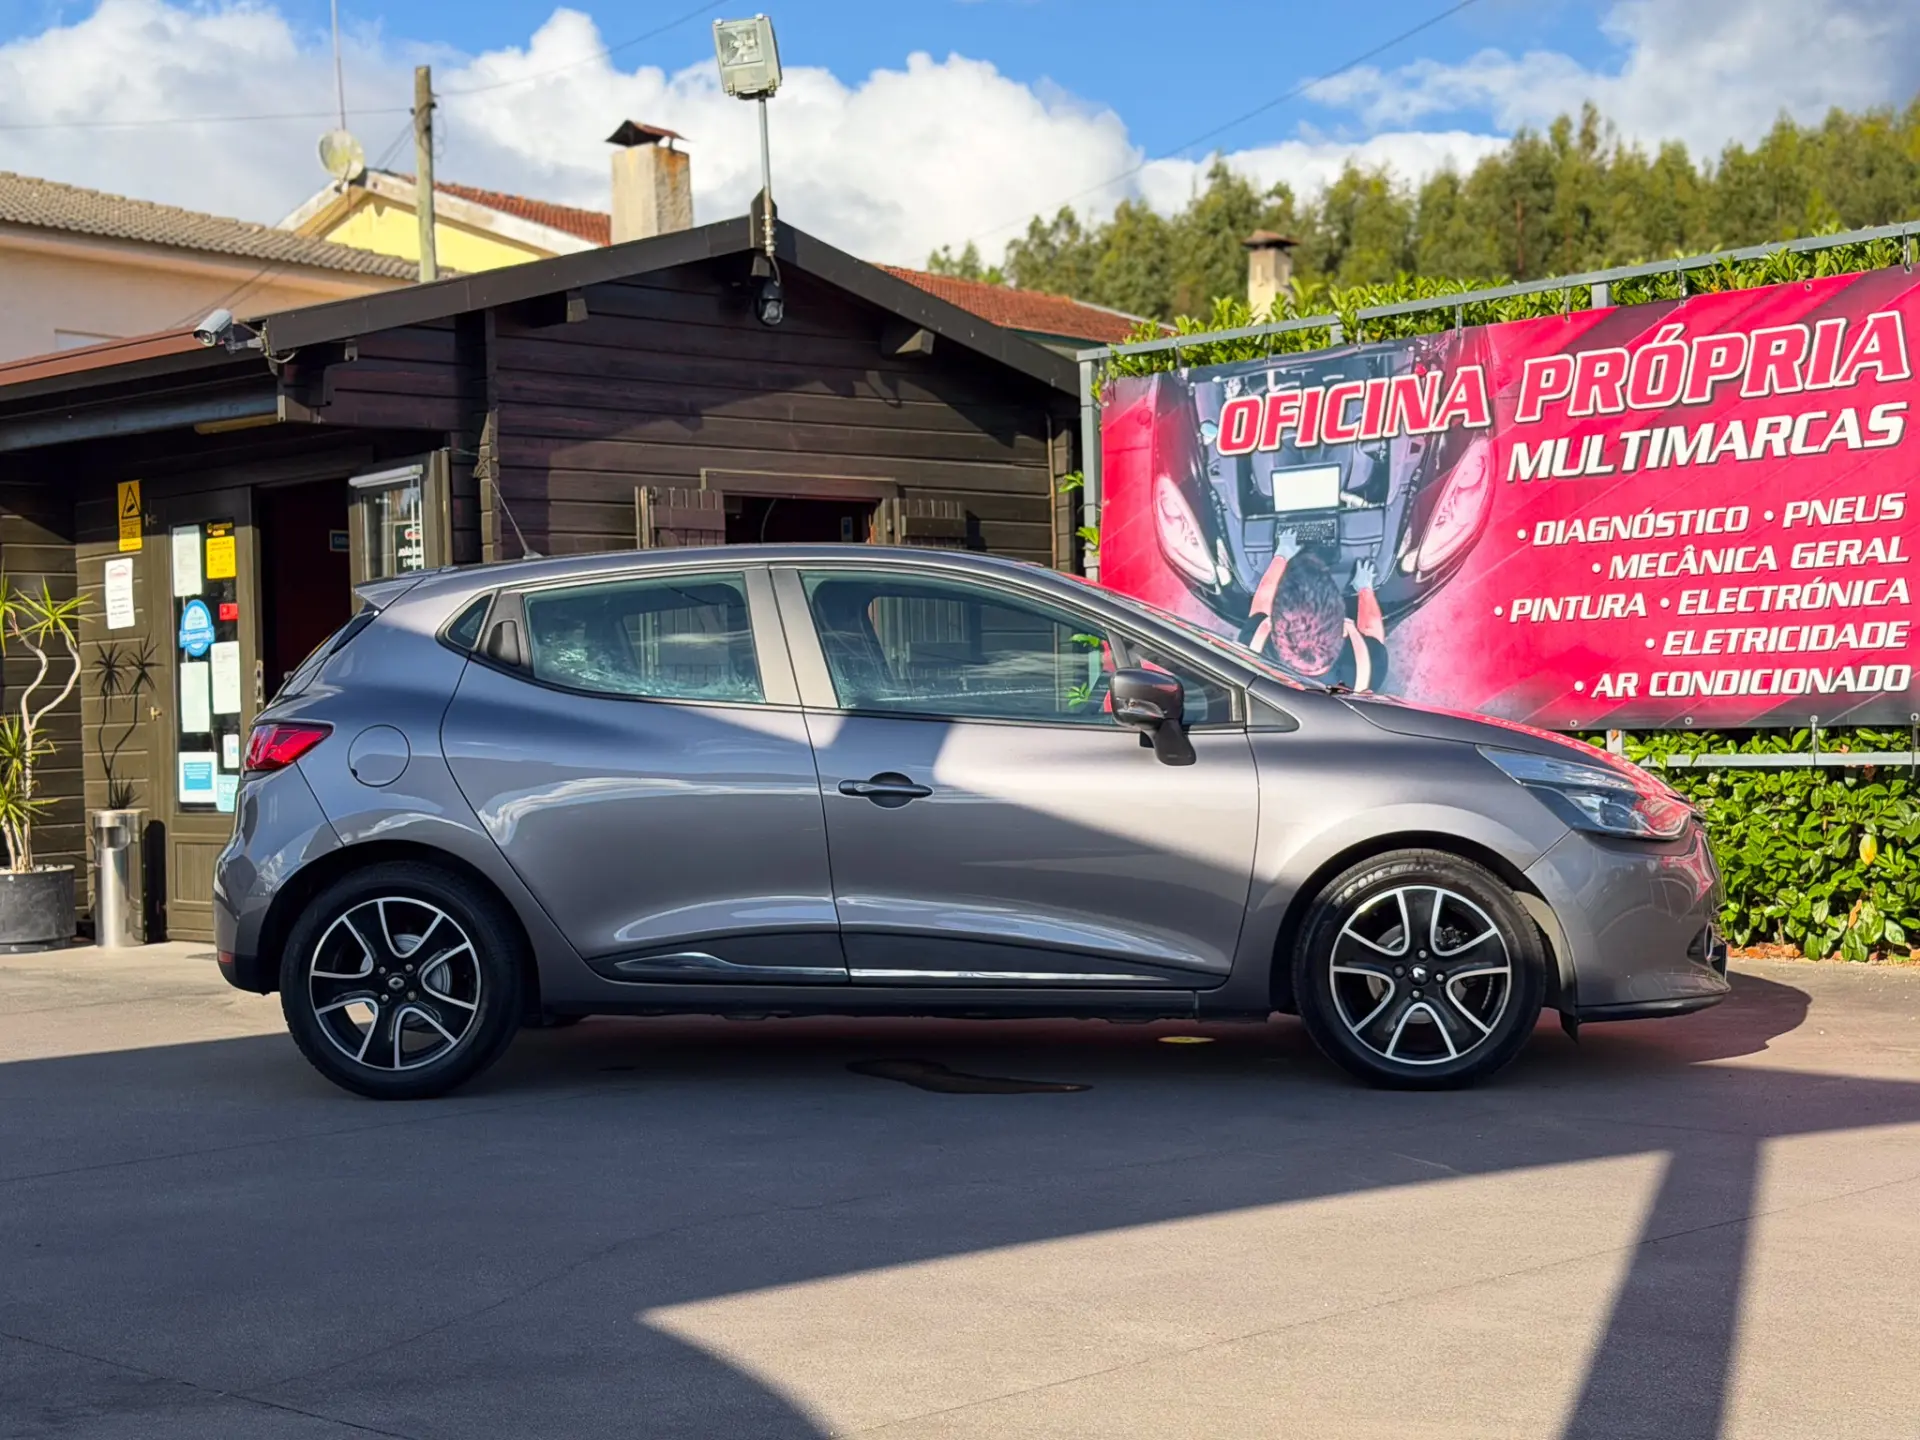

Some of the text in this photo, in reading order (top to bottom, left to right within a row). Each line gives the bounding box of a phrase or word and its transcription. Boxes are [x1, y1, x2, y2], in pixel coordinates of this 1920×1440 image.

[1216, 310, 1911, 456] OFICINA PRÓPRIA
[1506, 402, 1908, 482] MULTIMARCAS
[1533, 493, 1906, 546] DIAGNÓSTICO PNEUS
[1608, 536, 1910, 580] MECÂNICA GERAL
[1509, 577, 1911, 622] PINTURA ELECTRÓNICA
[1662, 621, 1911, 656] ELETRICIDADE
[1590, 664, 1912, 698] AR CONDICIONADO
